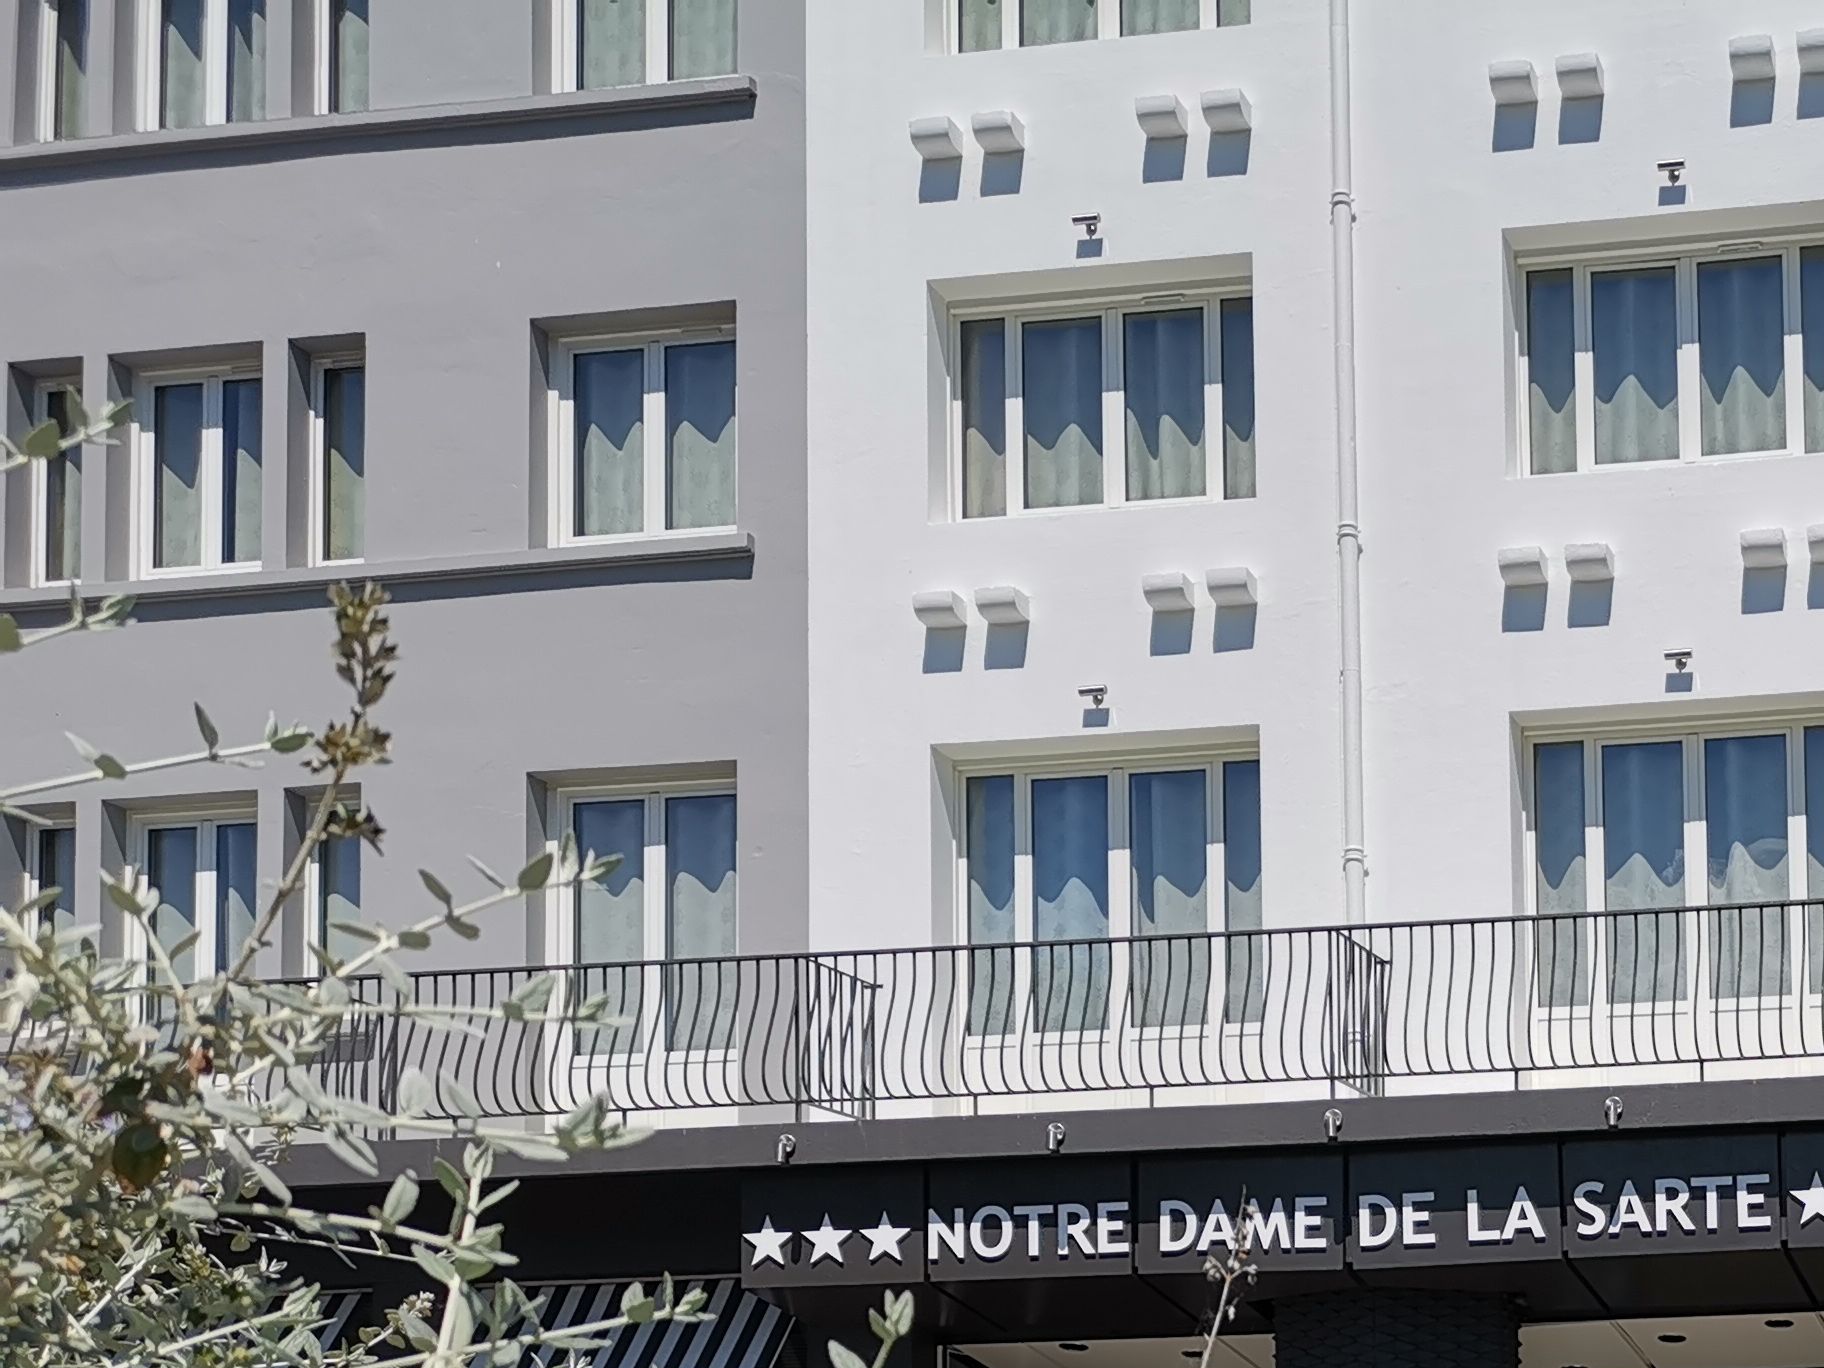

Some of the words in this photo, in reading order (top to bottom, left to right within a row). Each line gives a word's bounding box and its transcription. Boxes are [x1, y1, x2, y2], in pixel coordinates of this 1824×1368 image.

[928, 1202, 1129, 1261] NOTRE
[1159, 1197, 1327, 1254] DAME
[1358, 1191, 1436, 1248] DE
[1467, 1185, 1545, 1243] LA
[1574, 1174, 1771, 1239] SARTE
